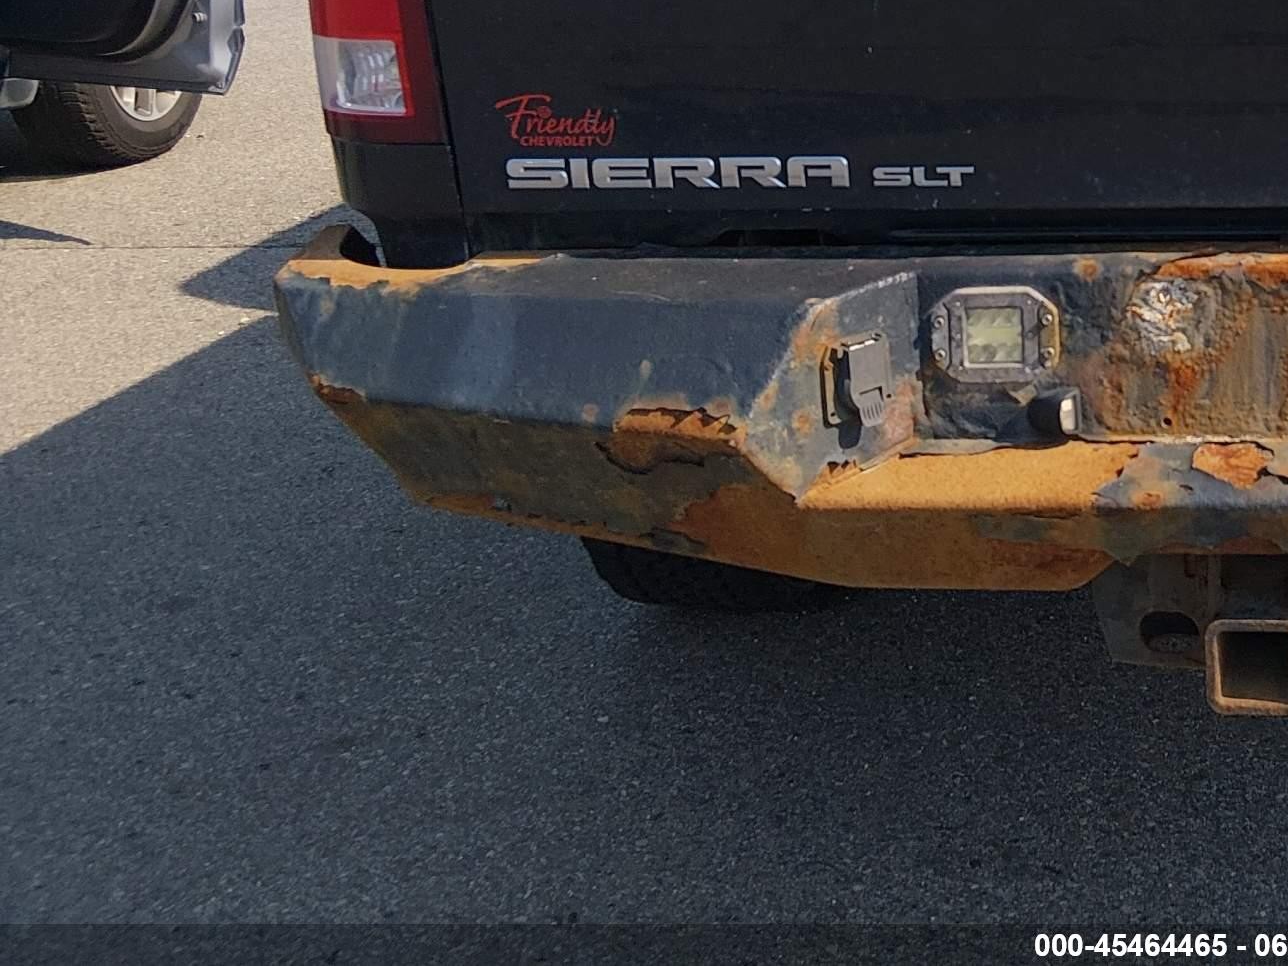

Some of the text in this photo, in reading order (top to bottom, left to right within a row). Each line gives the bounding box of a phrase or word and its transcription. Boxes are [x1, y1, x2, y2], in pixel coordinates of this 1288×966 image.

[496, 94, 615, 146] Friendly
[520, 136, 594, 147] CHEVROLET
[506, 155, 975, 190] SIERRA SLT
